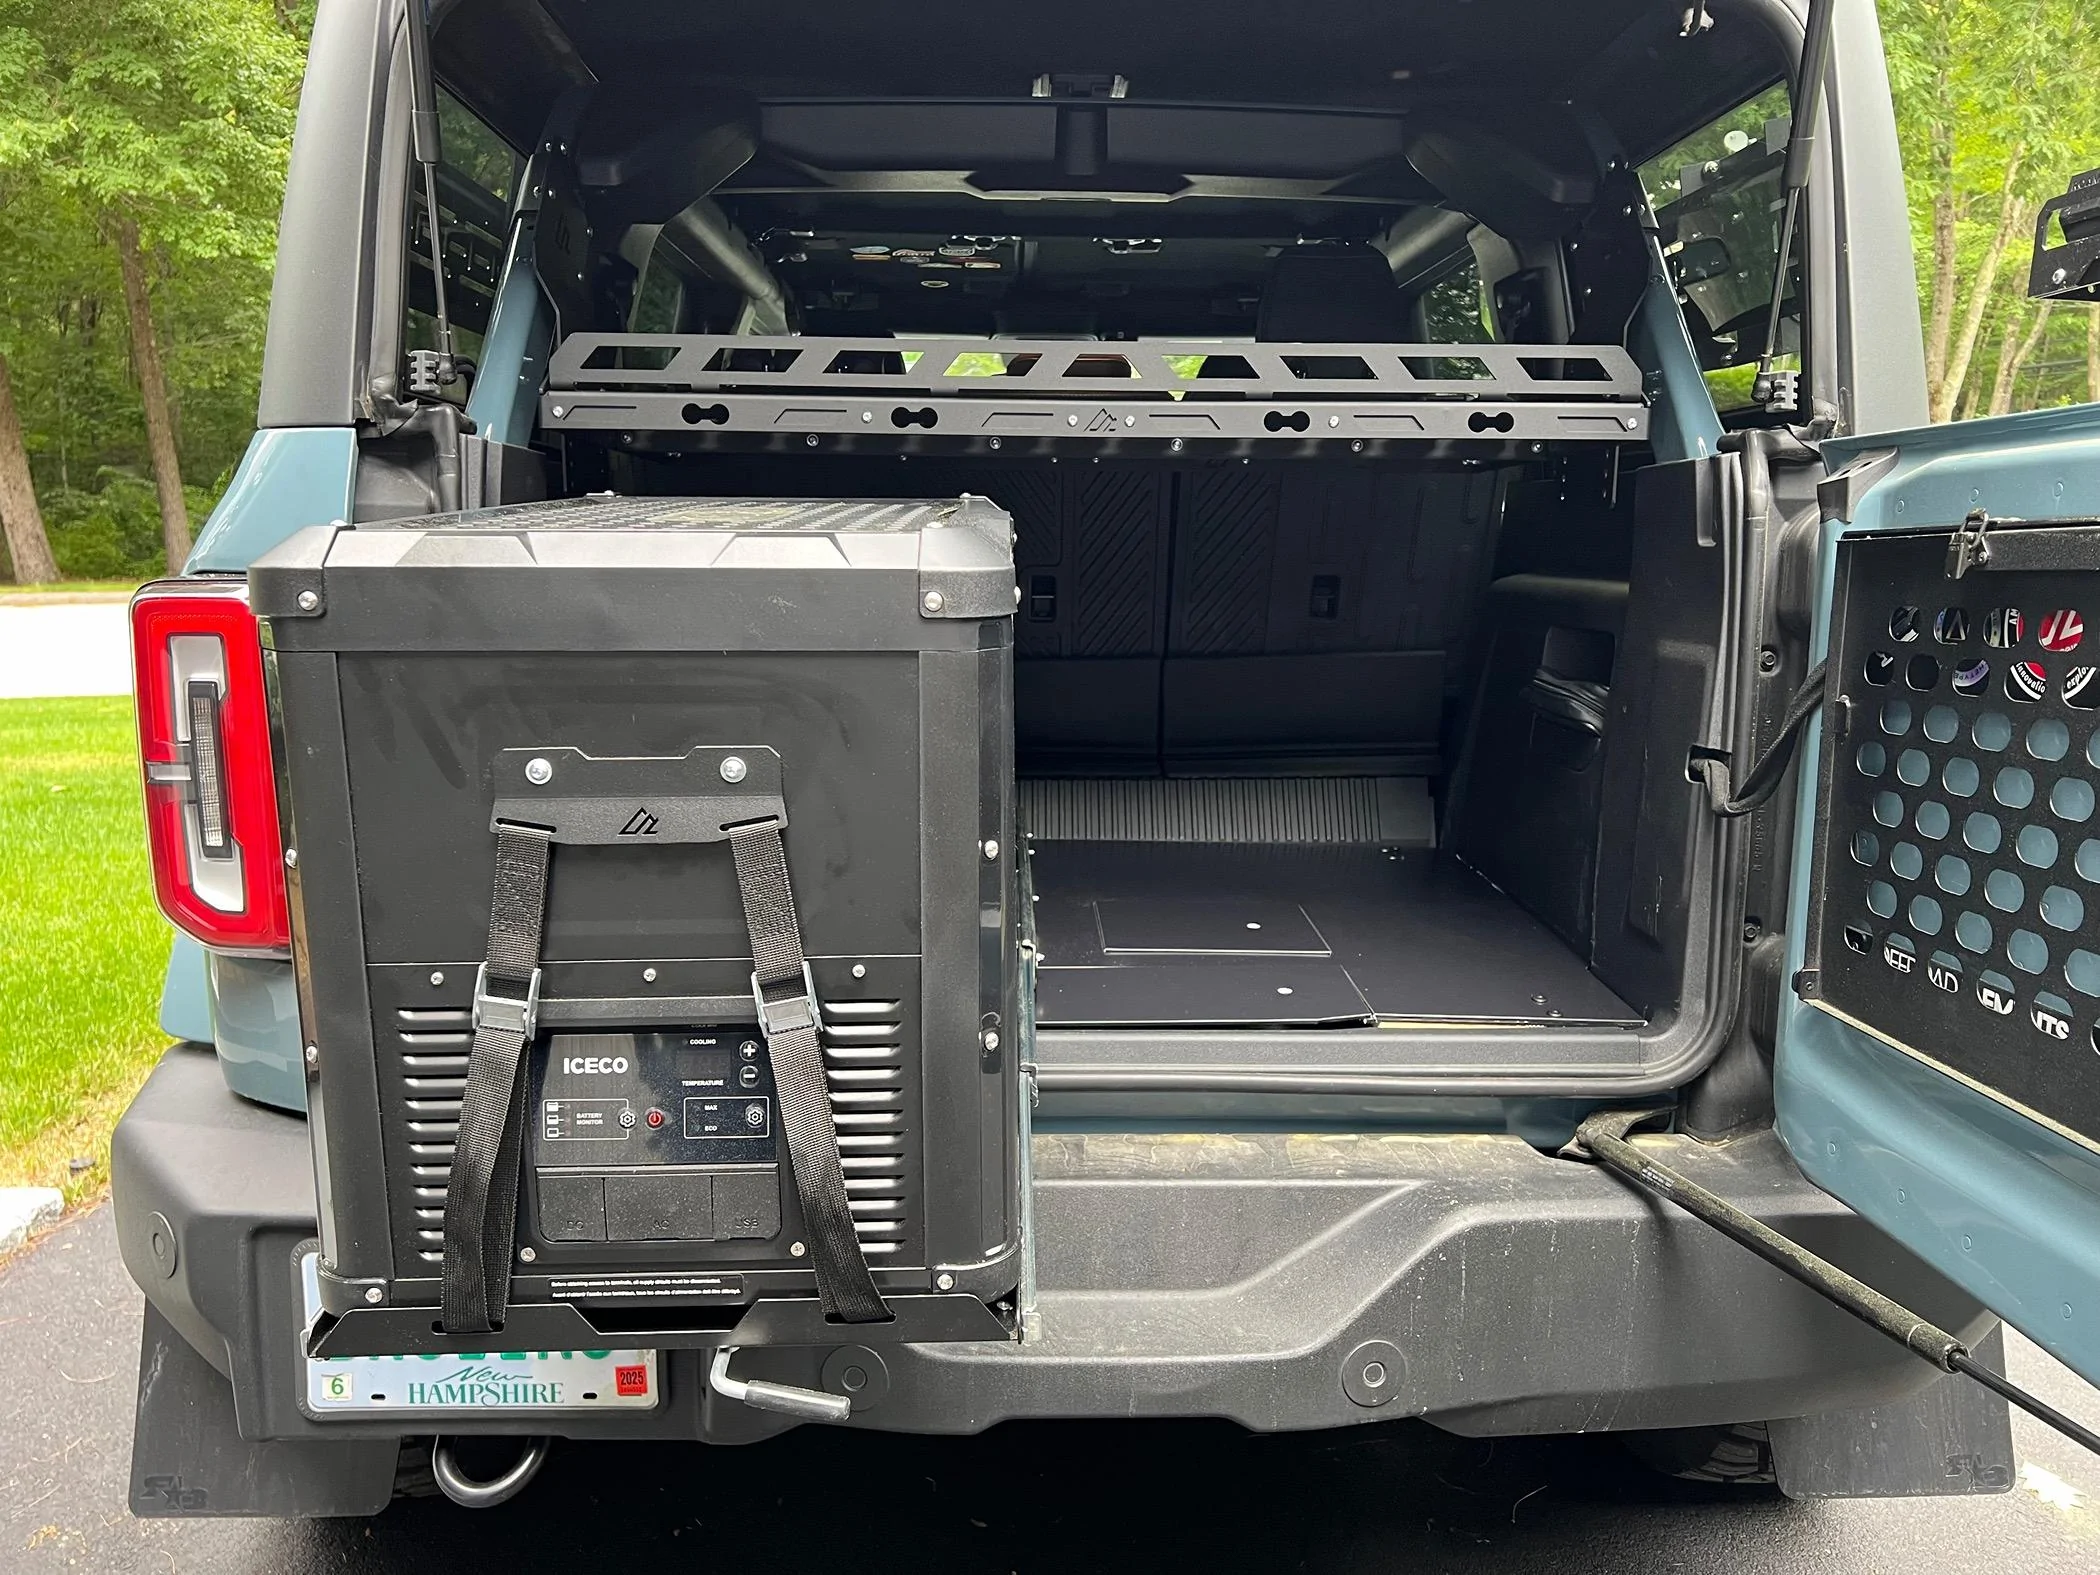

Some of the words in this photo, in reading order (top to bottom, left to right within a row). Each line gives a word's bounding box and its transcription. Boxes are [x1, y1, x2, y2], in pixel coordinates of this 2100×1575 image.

[2066, 666, 2090, 689] explo
[563, 1056, 629, 1075] ICECO
[681, 1079, 724, 1087] TEMPERATURE
[435, 1365, 534, 1383] New
[620, 1371, 644, 1385] 2025
[331, 1377, 344, 1395] 6
[408, 1382, 565, 1407] HAMPSHIRE
